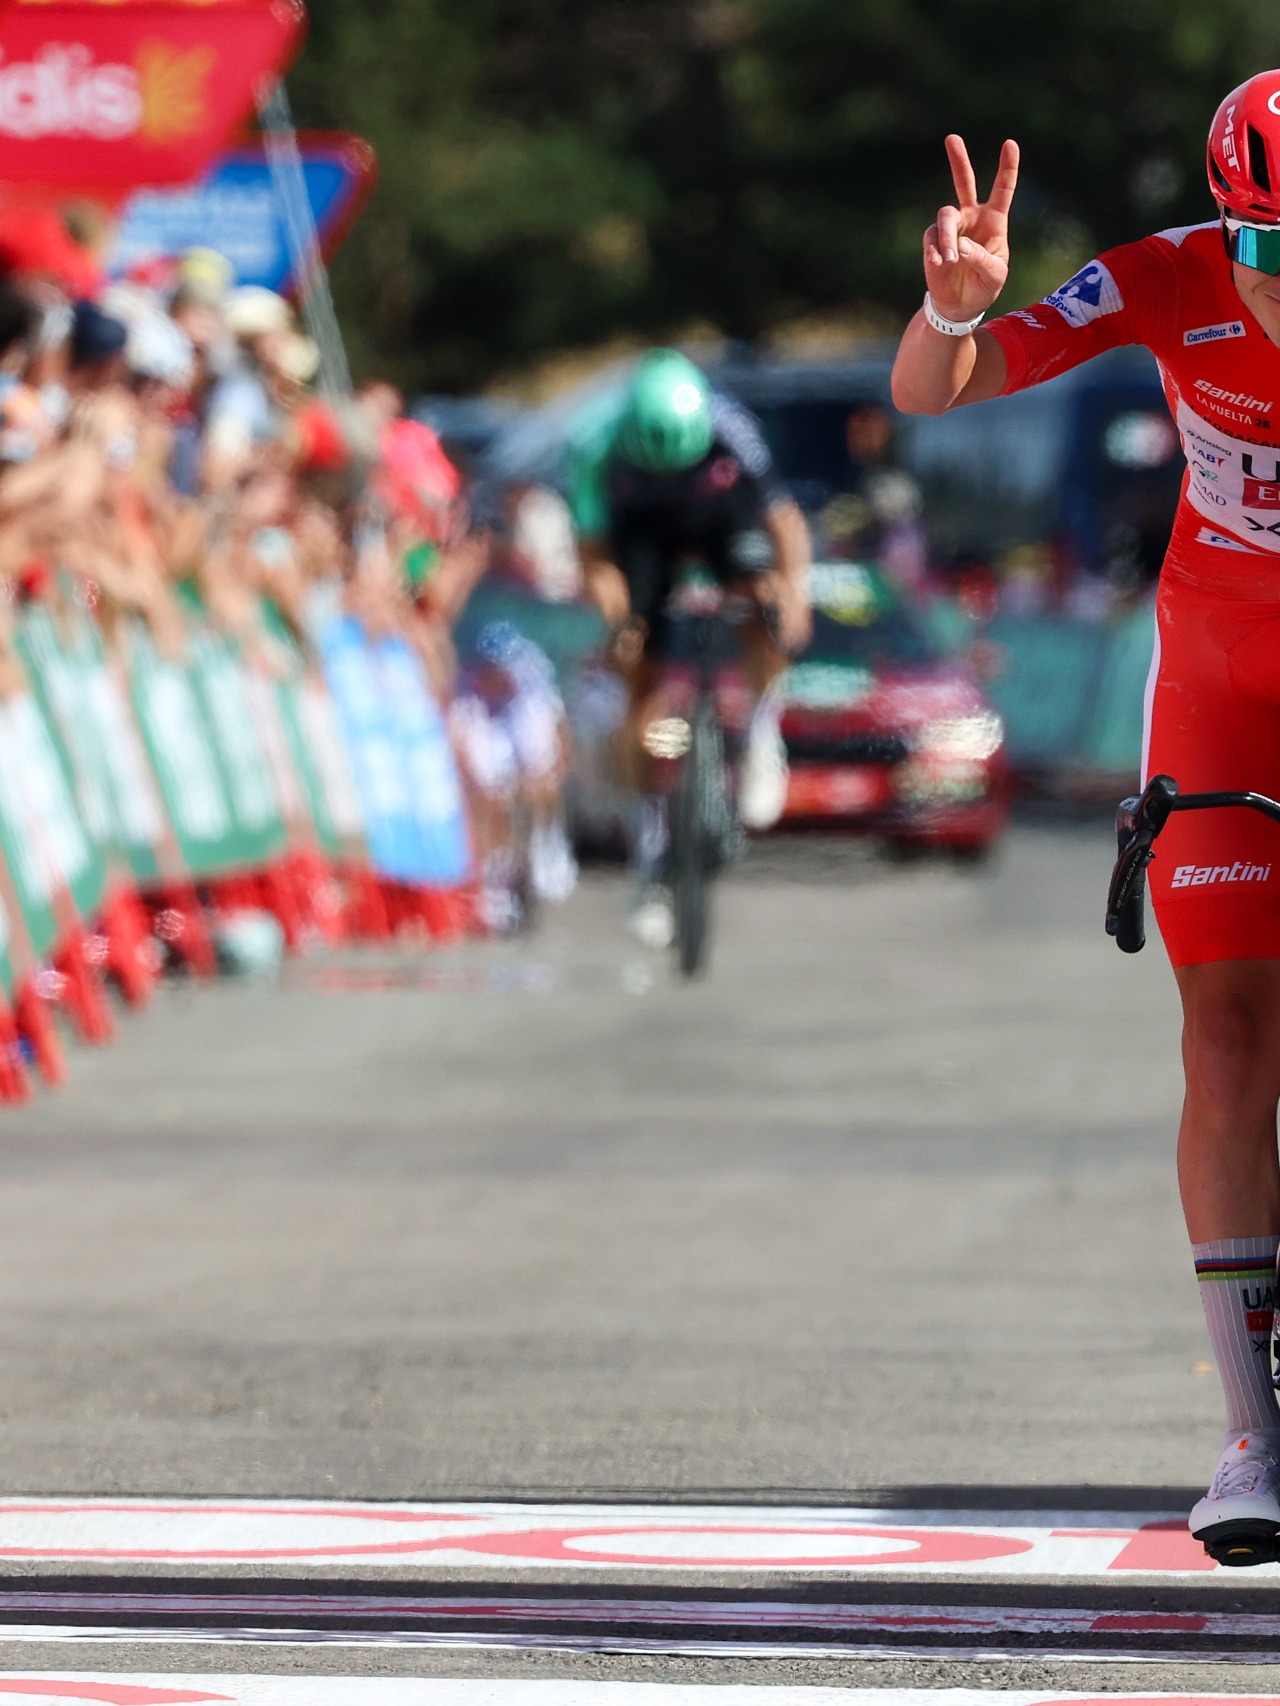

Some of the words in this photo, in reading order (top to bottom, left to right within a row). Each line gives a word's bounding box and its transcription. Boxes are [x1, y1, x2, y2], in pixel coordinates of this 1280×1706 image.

[0, 42, 143, 138] dis
[1222, 104, 1241, 173] MET
[1187, 328, 1227, 342] Carrefour
[1193, 379, 1274, 413] Santini
[1196, 393, 1209, 407] LA
[1209, 402, 1252, 425] VUELTA
[1171, 861, 1271, 888] Santini
